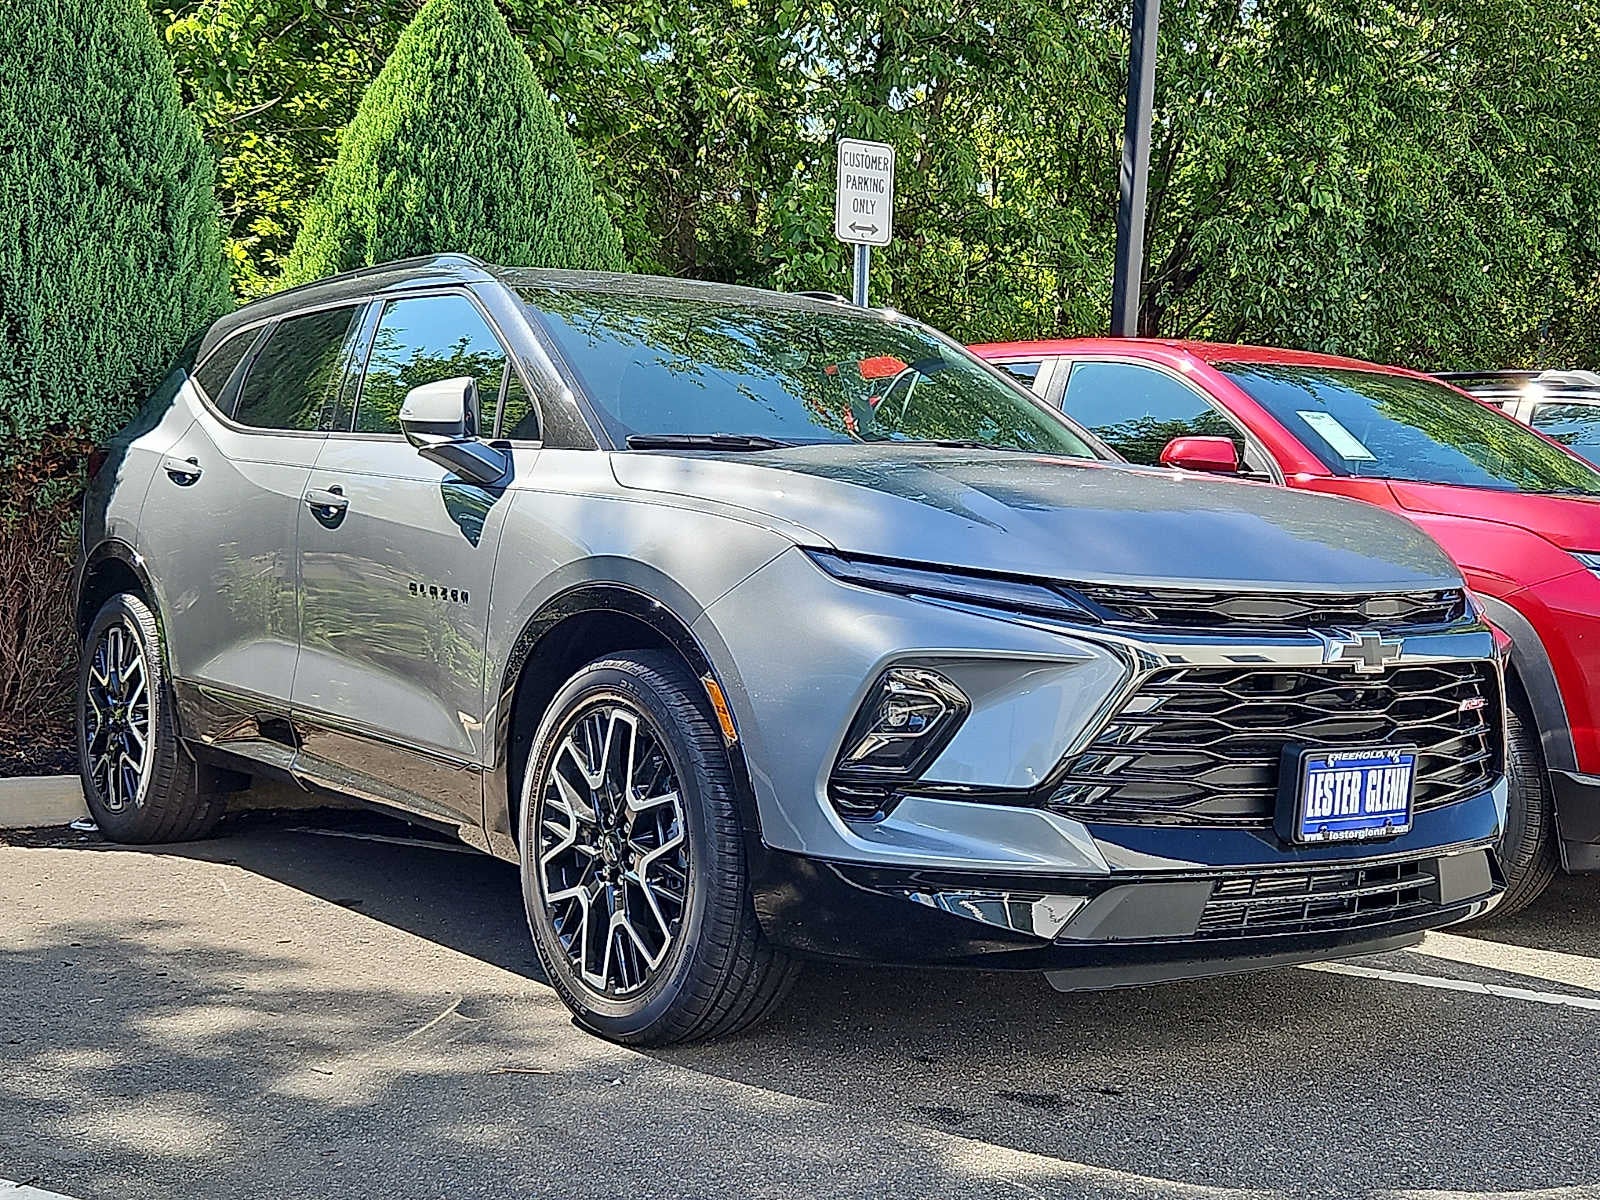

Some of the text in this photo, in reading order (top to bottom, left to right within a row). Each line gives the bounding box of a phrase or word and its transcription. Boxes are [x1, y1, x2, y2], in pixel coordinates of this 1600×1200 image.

[843, 152, 889, 171] CUSTOMER
[846, 175, 884, 193] PARKING
[852, 198, 876, 214] ONLY
[1307, 768, 1411, 817] LESTER GLENN
